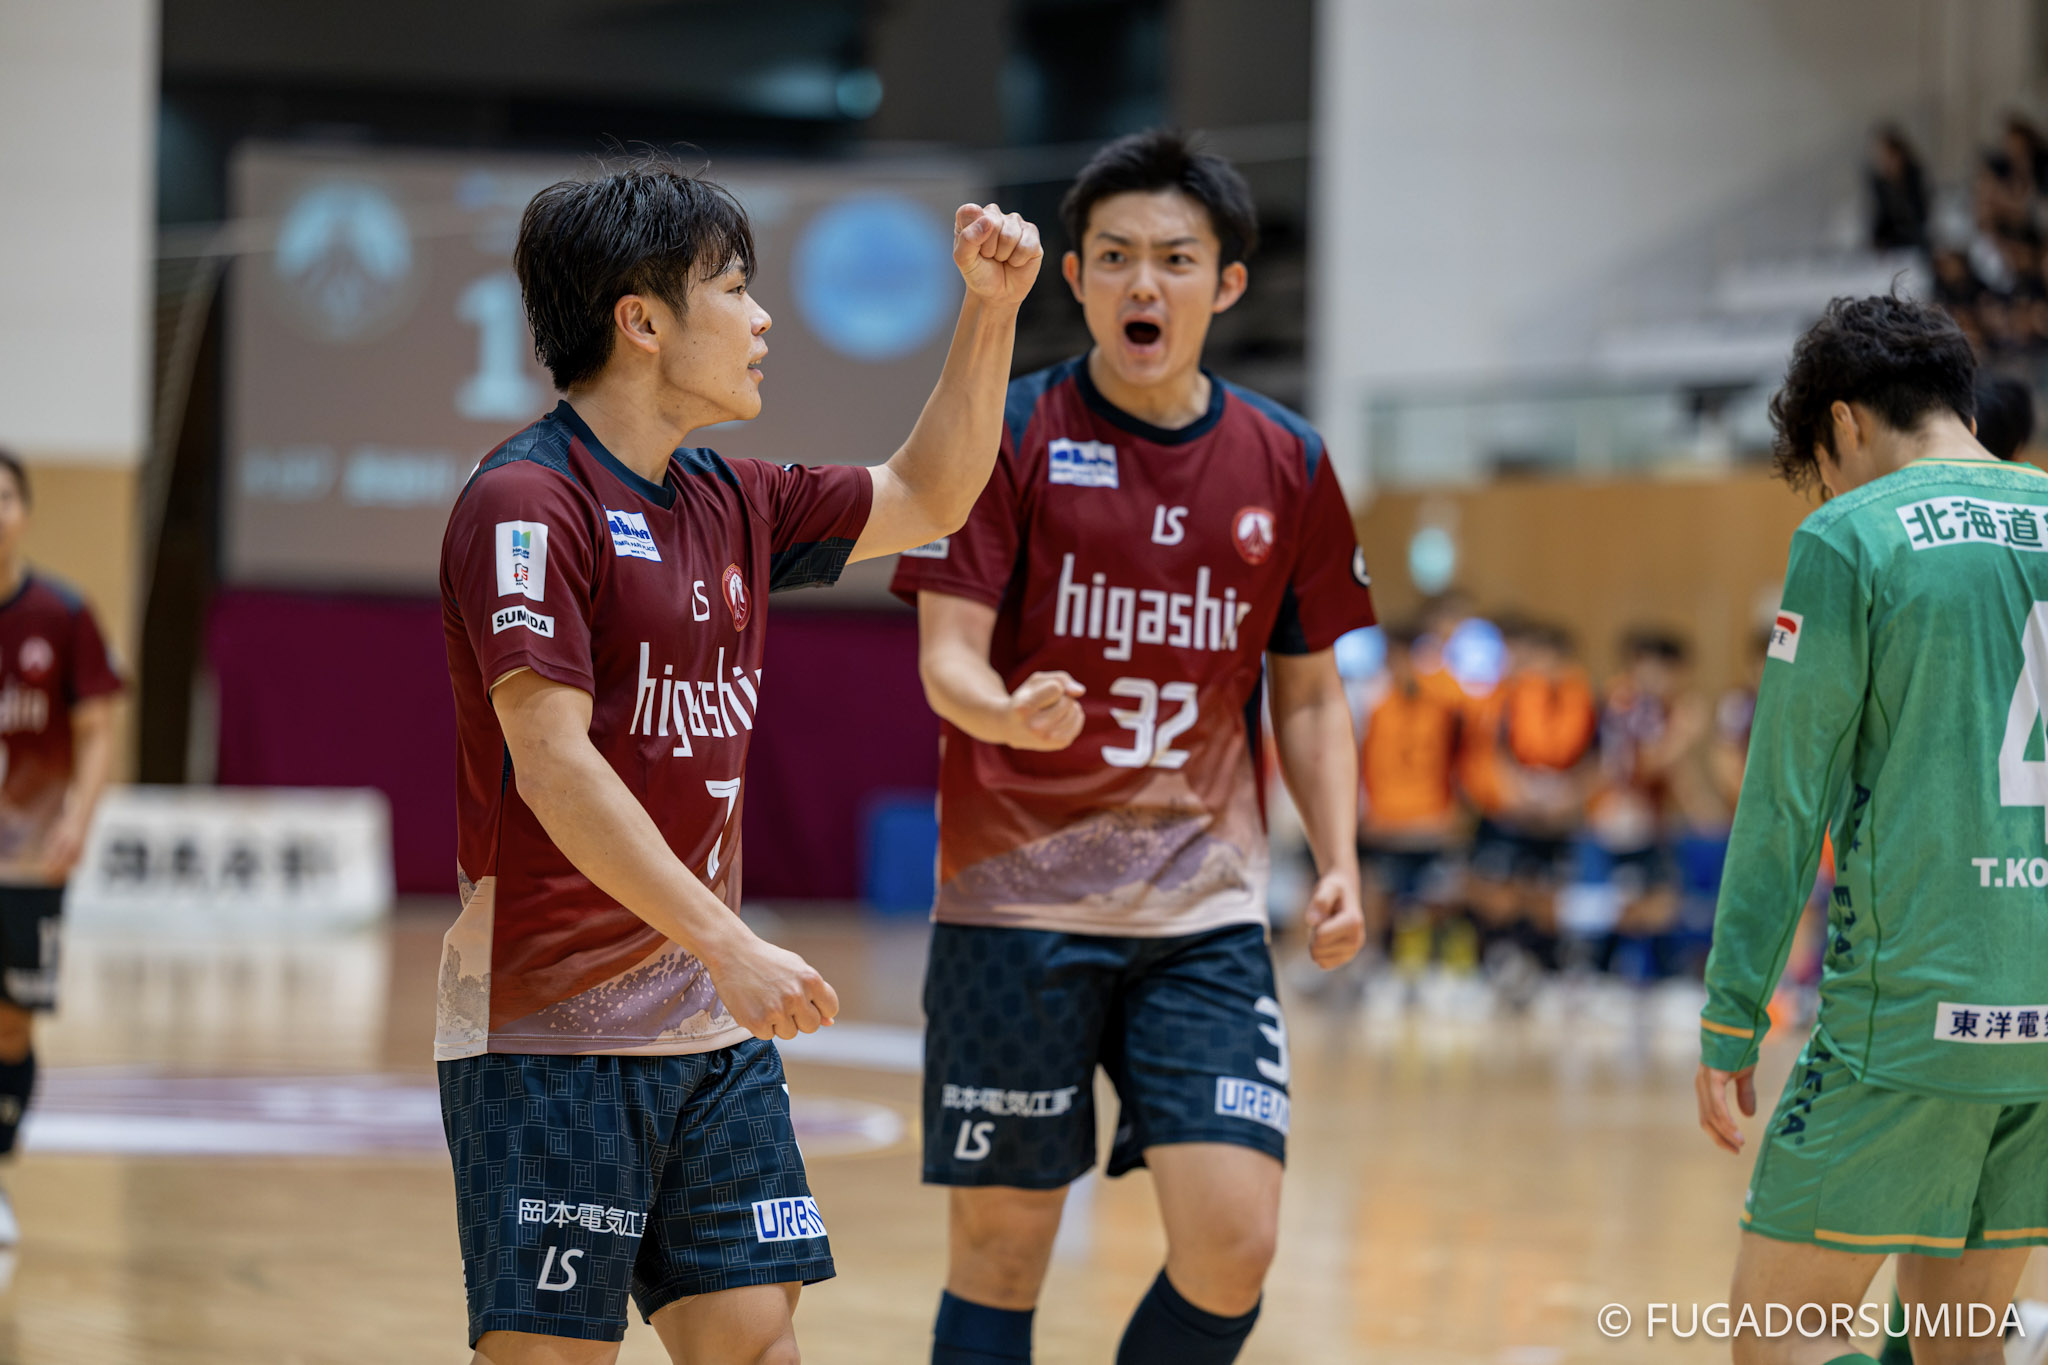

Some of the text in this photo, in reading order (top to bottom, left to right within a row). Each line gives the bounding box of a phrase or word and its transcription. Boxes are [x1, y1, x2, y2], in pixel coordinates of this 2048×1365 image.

[459, 277, 541, 418] 1
[1906, 500, 2048, 547] 北海道
[497, 610, 549, 633] SUMIDA
[629, 642, 763, 757] higashi
[1101, 676, 1199, 769] 32
[705, 777, 741, 880] 7
[1254, 995, 1289, 1085] 3
[1949, 1010, 2048, 1038] 東洋電
[519, 1198, 648, 1237] 岡本電気工
